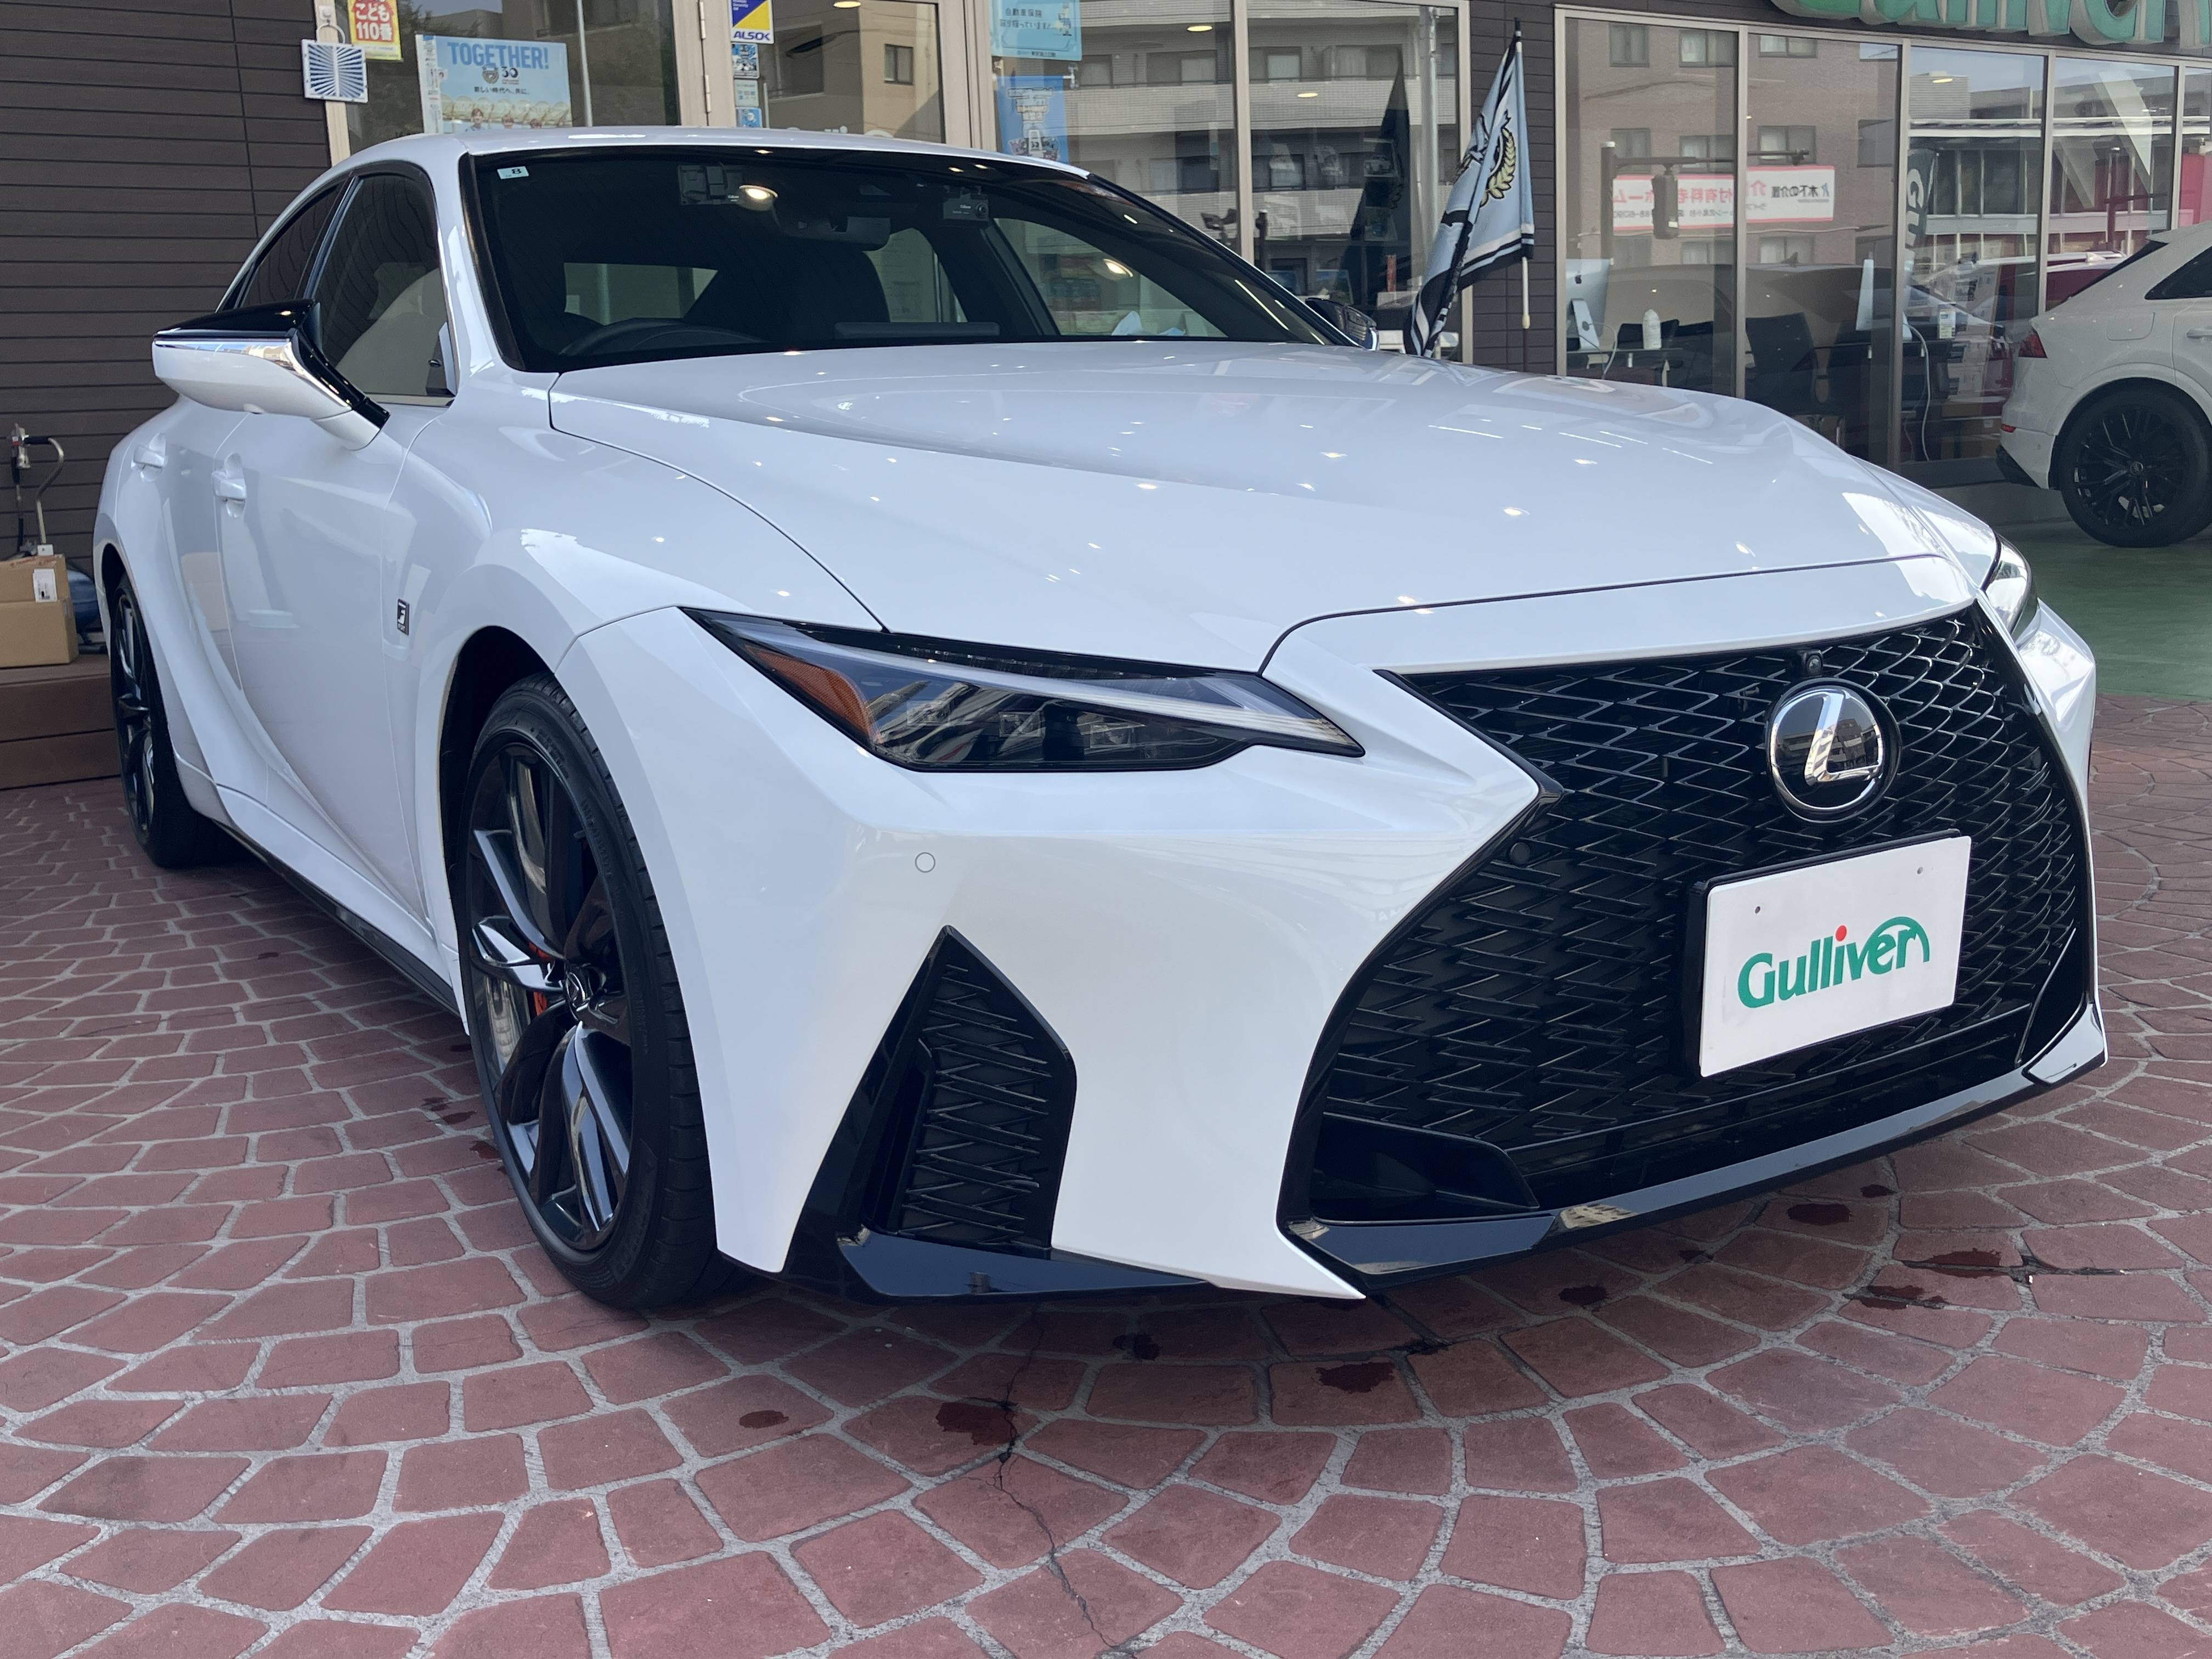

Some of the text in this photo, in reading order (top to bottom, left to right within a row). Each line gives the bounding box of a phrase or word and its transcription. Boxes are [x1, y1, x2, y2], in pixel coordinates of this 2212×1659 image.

[356, 3, 390, 22] こども
[357, 22, 392, 41] 110番
[733, 31, 770, 41] ALSOK
[448, 42, 549, 70] TOGETHER!
[1737, 916, 1930, 1008] Gulliver
